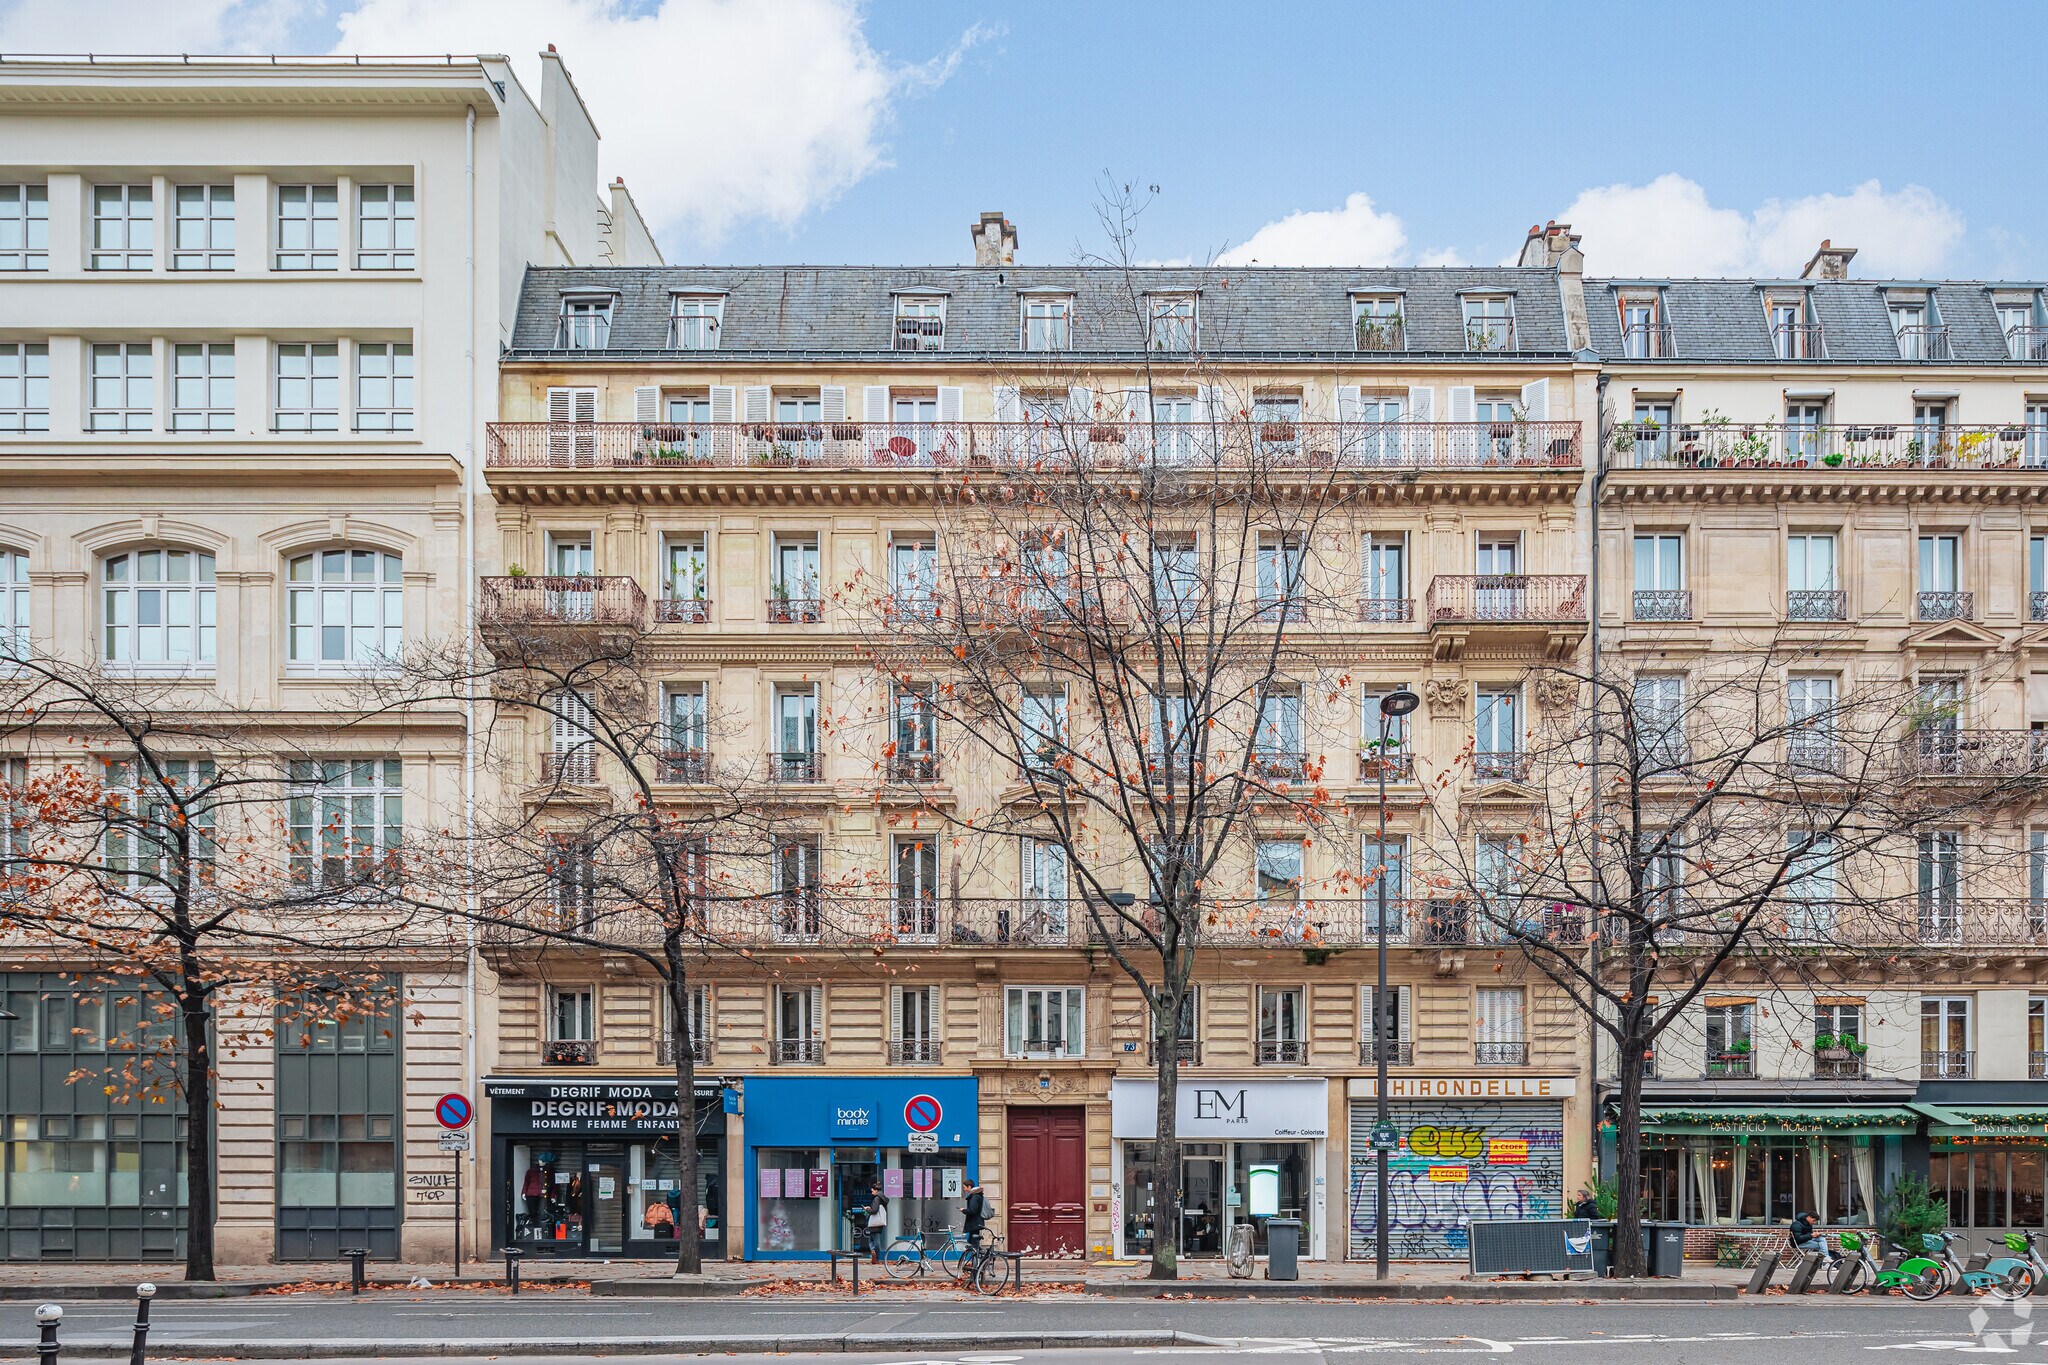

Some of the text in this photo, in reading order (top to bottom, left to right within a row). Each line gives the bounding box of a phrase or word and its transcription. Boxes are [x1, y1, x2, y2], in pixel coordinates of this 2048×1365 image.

[1125, 1043, 1135, 1051] 73
[489, 1087, 525, 1095] VÊTEMENT
[550, 1087, 652, 1097] DEGRIF MODA
[531, 1101, 679, 1117] DEGRIF MODA
[1193, 1089, 1248, 1119] EM
[837, 1107, 870, 1119] body
[532, 1120, 680, 1129] HOMME FEMME ENFANT
[837, 1118, 869, 1126] minute
[1710, 1122, 1766, 1132] PASTIFICIO
[1974, 1123, 2029, 1133] PASTIFICIO
